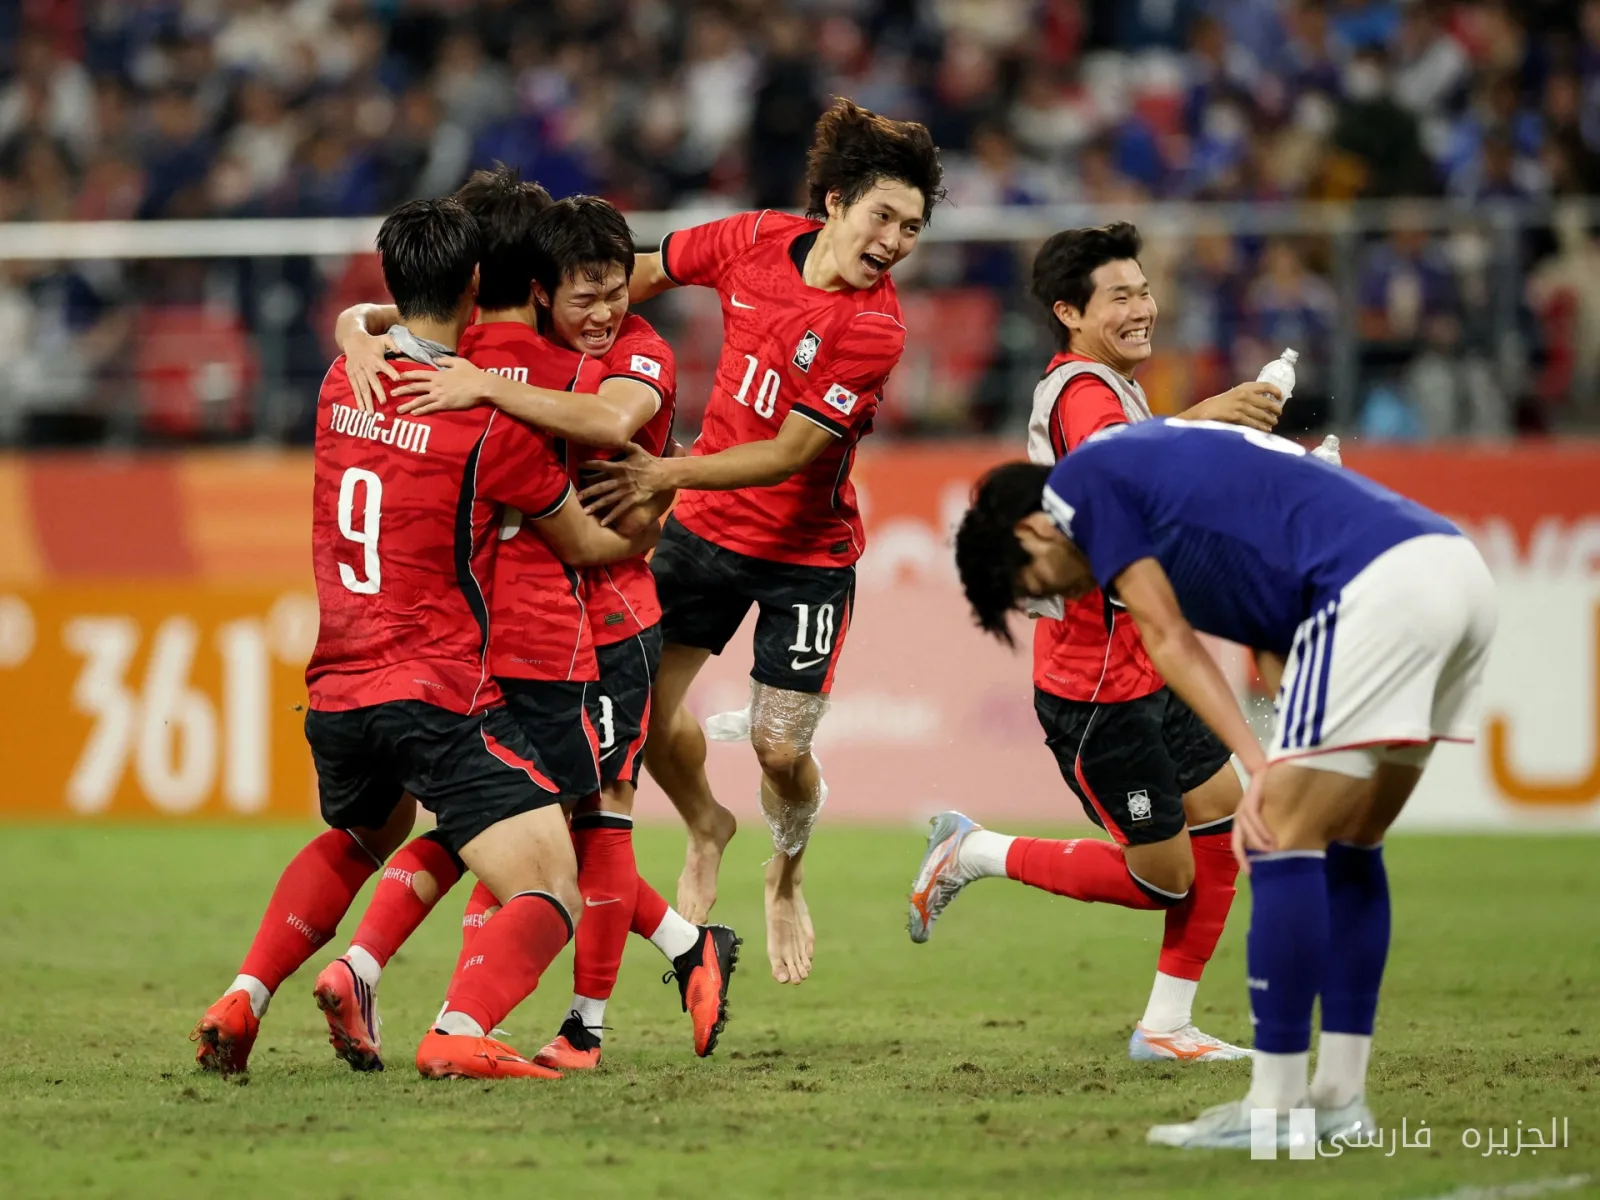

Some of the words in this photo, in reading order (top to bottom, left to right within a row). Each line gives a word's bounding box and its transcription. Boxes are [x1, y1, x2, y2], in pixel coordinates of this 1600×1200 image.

[732, 354, 781, 419] 10
[337, 467, 382, 594] 9
[788, 603, 834, 655] 10
